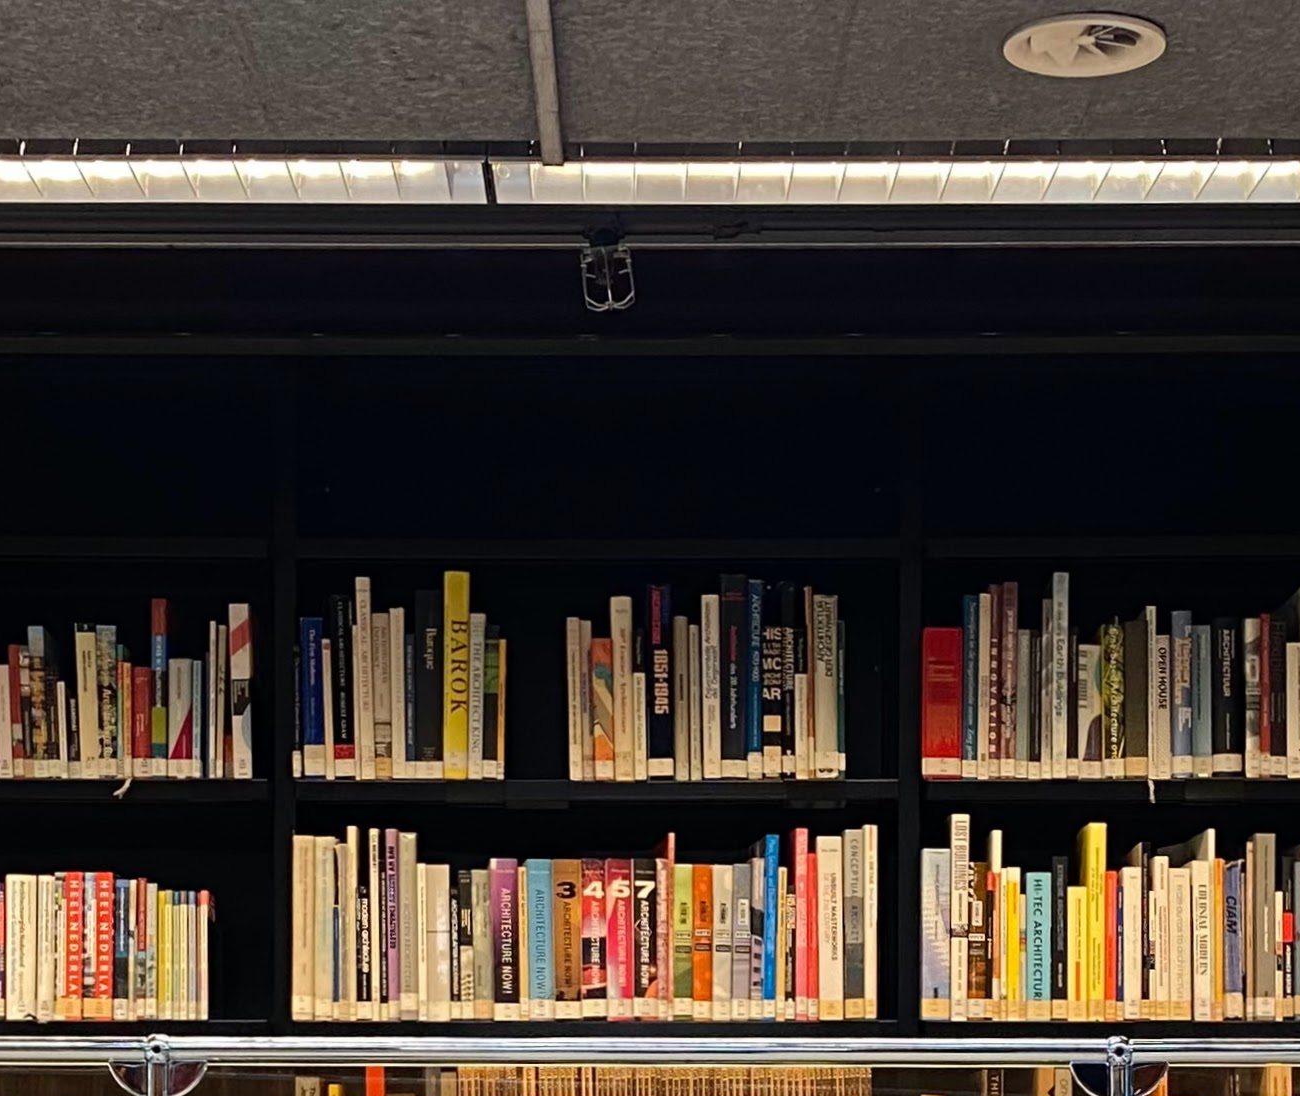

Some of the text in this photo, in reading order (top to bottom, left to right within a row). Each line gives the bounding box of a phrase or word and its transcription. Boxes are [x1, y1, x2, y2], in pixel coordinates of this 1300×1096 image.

[360, 600, 370, 712] CLASSICAL ARCHITECTURE
[424, 628, 438, 670] Baroque
[785, 627, 794, 691] ARCHITECTURE
[816, 600, 826, 662] ARCHITEKTUR
[1223, 629, 1231, 697] ARCHITECTUUR
[451, 619, 469, 714] BAROK
[473, 641, 481, 753] THE ARCHITECT KING
[990, 638, 998, 753] INNOVATION
[1055, 638, 1066, 718] Earth Buildings
[1159, 647, 1168, 710] OPEN HOUSE
[339, 719, 347, 740] ADAM
[1109, 685, 1120, 743] Architecture
[955, 819, 968, 892] LOST BUILDINGS
[70, 880, 79, 918] HEEL
[100, 880, 109, 918] HEEL
[555, 881, 578, 899] 3
[583, 880, 605, 899] 4
[634, 879, 656, 899] 7
[1033, 878, 1043, 917] HI-TEC
[1226, 895, 1238, 936] CIAM
[362, 897, 370, 974] modern architecture
[500, 888, 512, 995] ARCHITECTURE NOW!
[536, 889, 547, 964] ARCHITECTURE
[563, 901, 573, 989] ARCHITECTURE NOW!
[591, 900, 600, 963] ARCHITECTURE
[618, 900, 627, 987] ARCHITECTURE NOW!
[641, 900, 650, 988] ARCHITECTURE NOW!
[1199, 884, 1209, 977] COLONIAL MODERN
